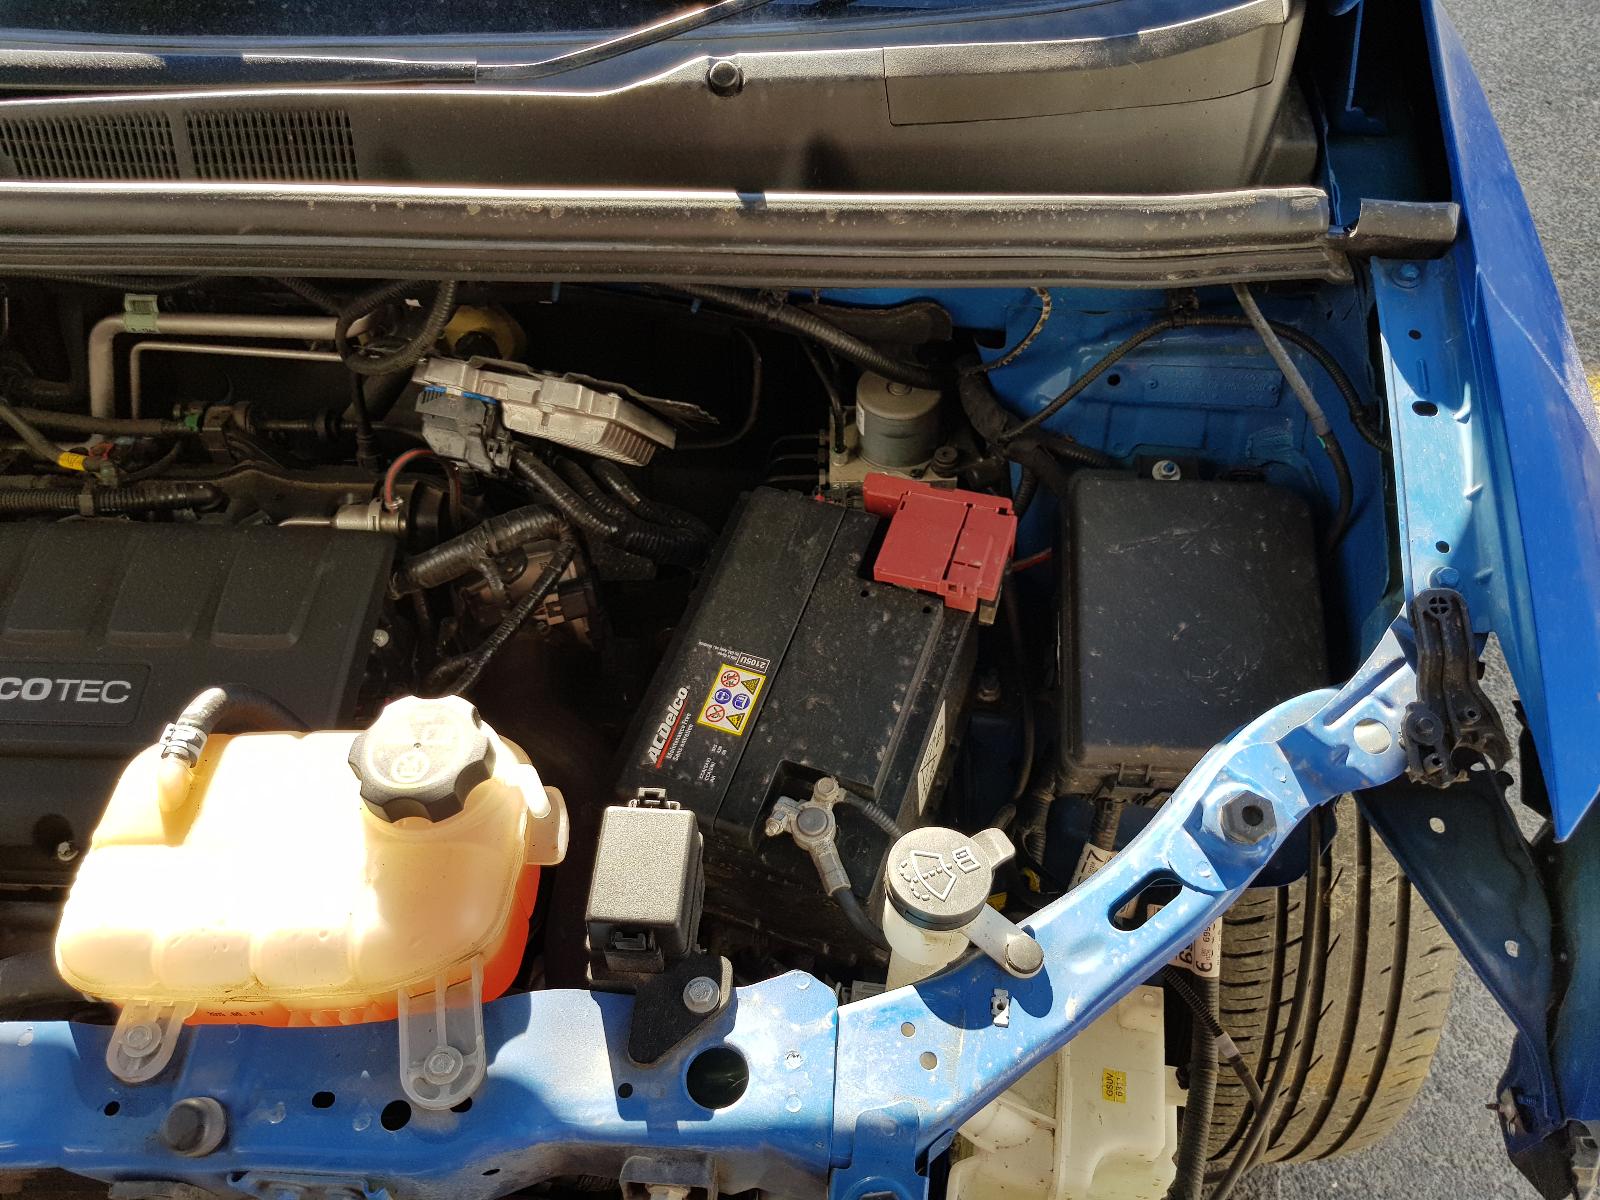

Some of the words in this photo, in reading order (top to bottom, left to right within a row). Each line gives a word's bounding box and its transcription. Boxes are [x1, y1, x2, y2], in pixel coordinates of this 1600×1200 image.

[739, 655, 766, 668] 2105U
[646, 685, 690, 764] ACDelco
[1105, 1072, 1113, 1096] GSUV
